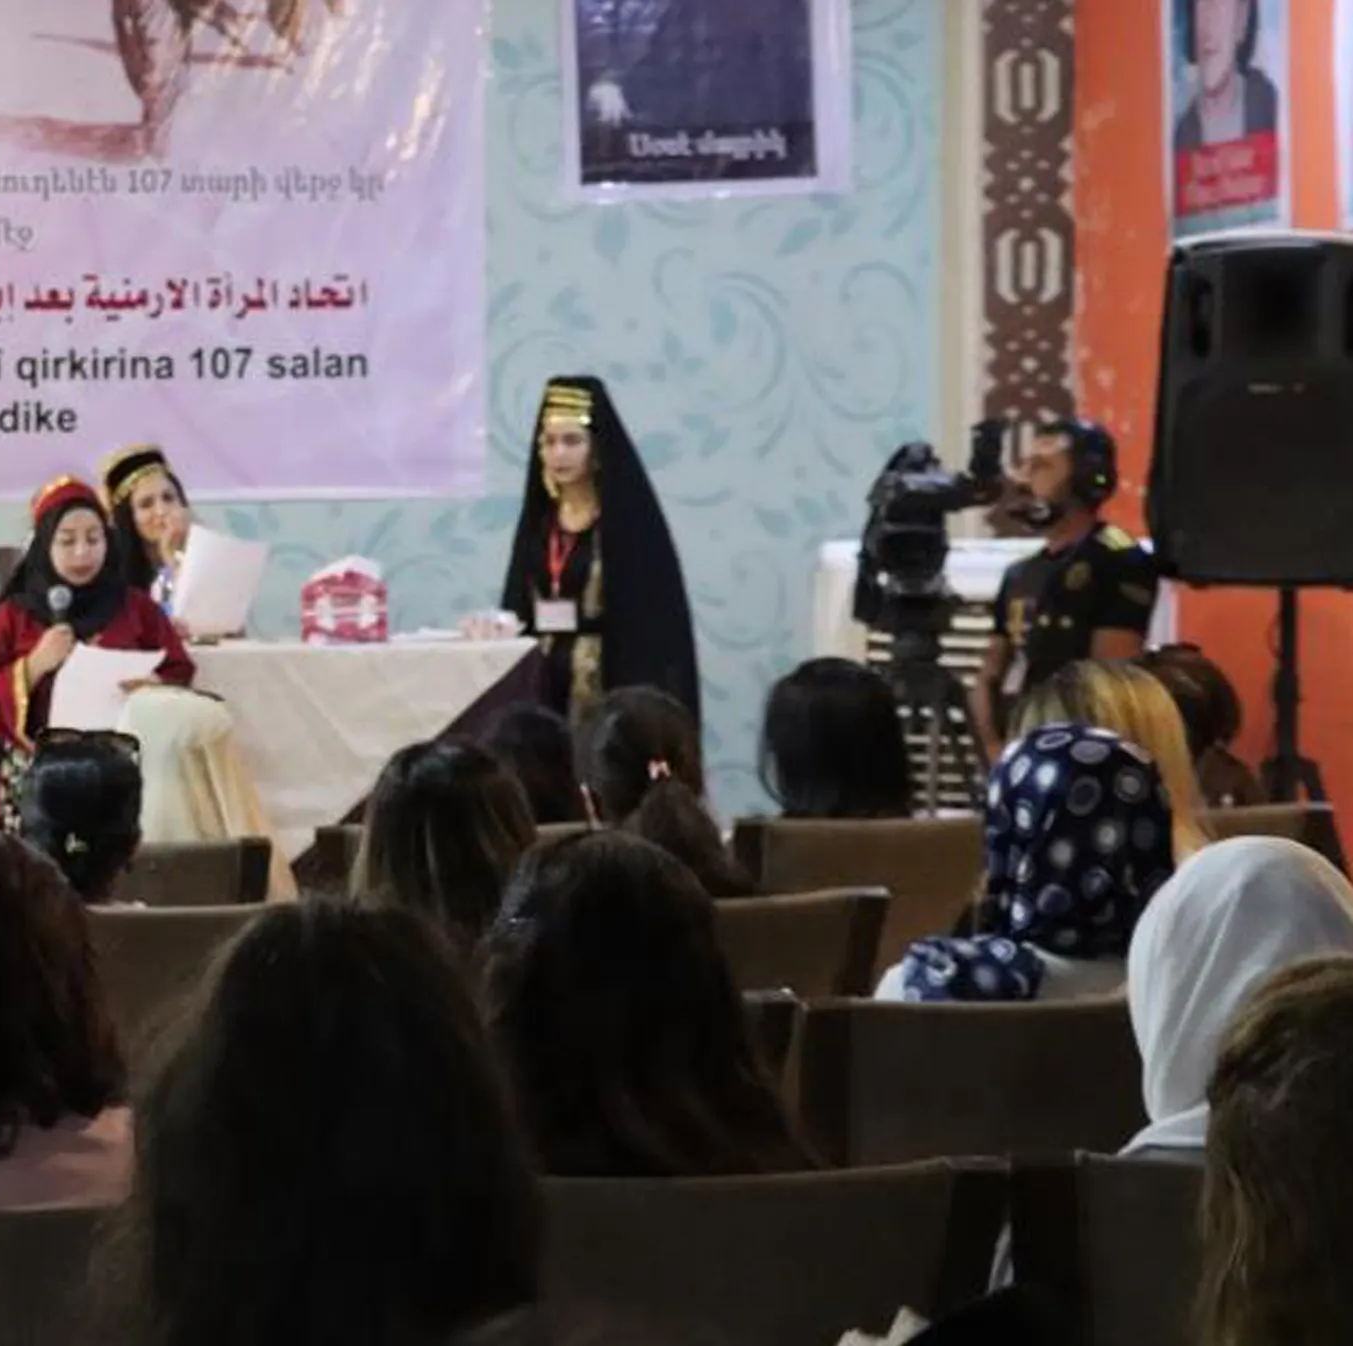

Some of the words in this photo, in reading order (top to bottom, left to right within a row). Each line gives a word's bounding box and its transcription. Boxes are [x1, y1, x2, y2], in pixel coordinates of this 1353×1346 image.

[128, 168, 172, 194] 107
[24, 284, 75, 324] بعد
[82, 273, 200, 321] الارمنية
[207, 272, 278, 320] المرأة
[288, 273, 367, 310] اتحاد
[16, 347, 174, 389] qirkirina
[191, 347, 254, 380] 107
[267, 347, 368, 380] salan
